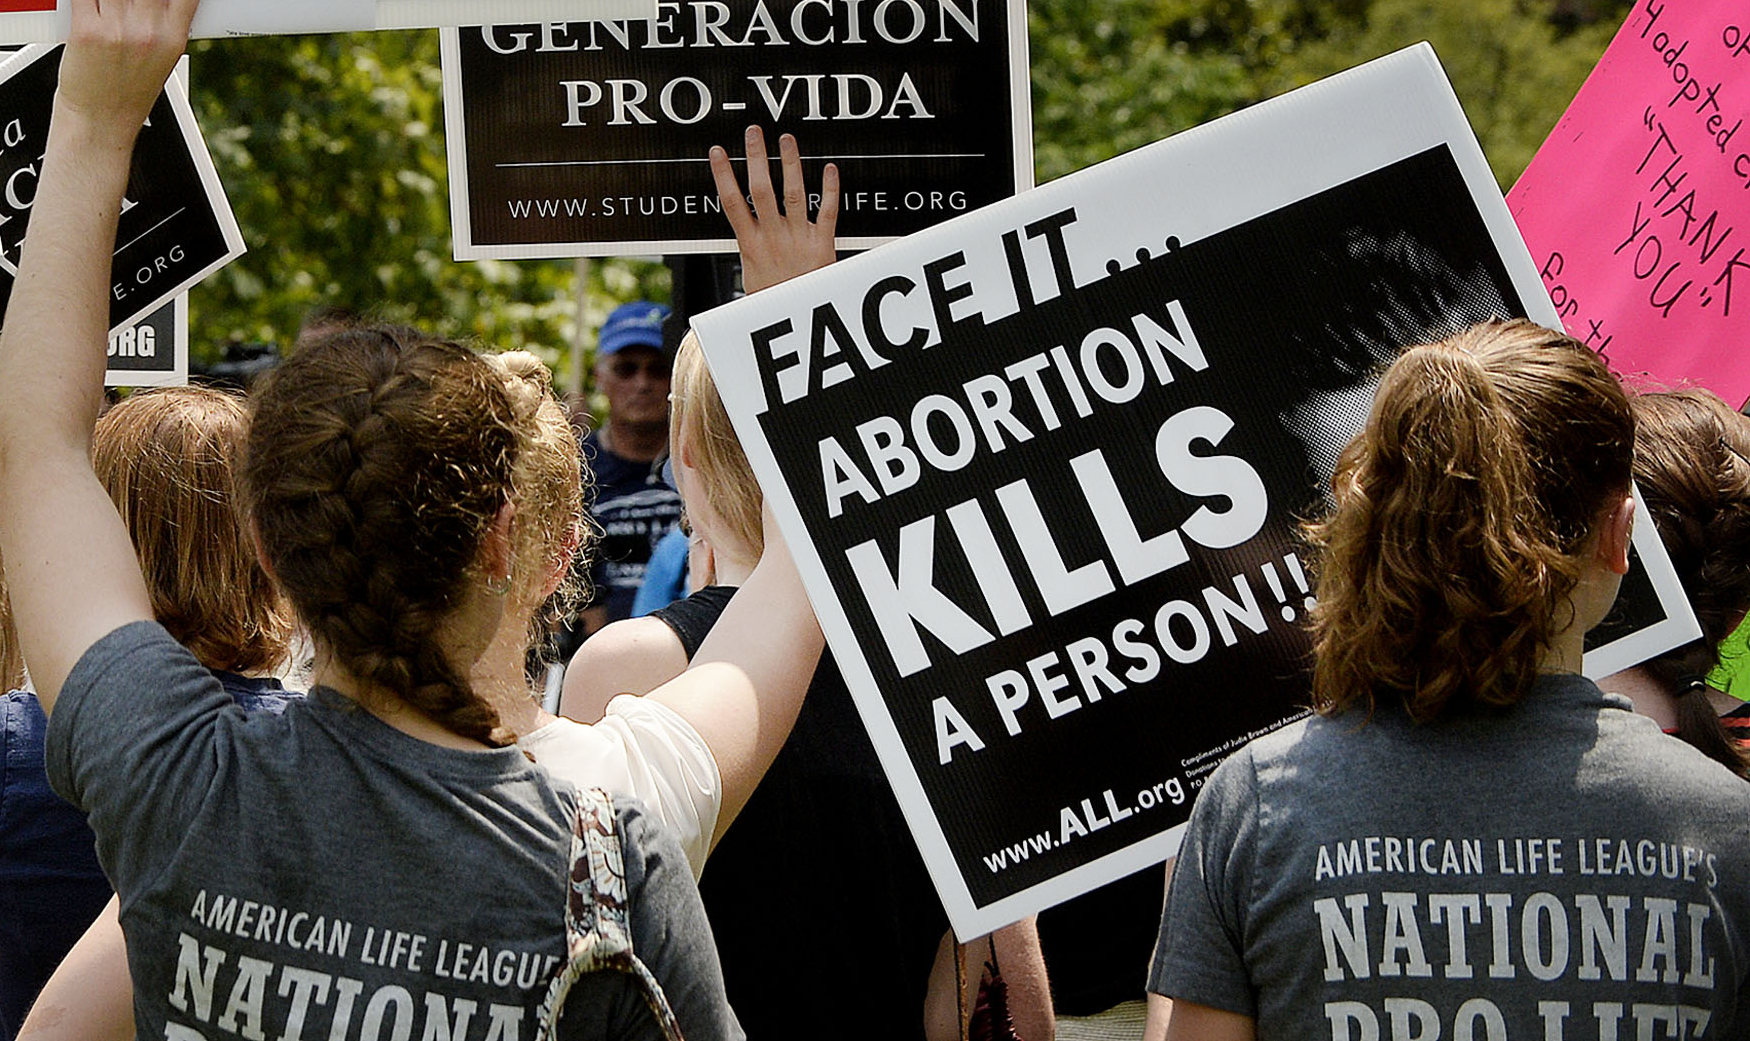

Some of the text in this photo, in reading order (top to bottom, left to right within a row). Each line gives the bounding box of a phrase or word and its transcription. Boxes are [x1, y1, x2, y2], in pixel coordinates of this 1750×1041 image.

[561, 71, 934, 127] PRO-VIDA
[1652, 32, 1743, 154] adopted
[750, 207, 1182, 415] FACE IT...
[818, 299, 1210, 518] ABORTION
[845, 405, 1269, 678] KILLS
[932, 695, 986, 766] A
[1181, 746, 1223, 767] Compliments
[1247, 726, 1269, 741] Brown
[982, 774, 1186, 873] www.ALL.org
[1314, 837, 1718, 888] AMERICAN LIFE LEAGUE'S
[190, 889, 352, 958] AMERICAN
[360, 926, 427, 972] LIFE
[1313, 891, 1716, 989] NATIONAL
